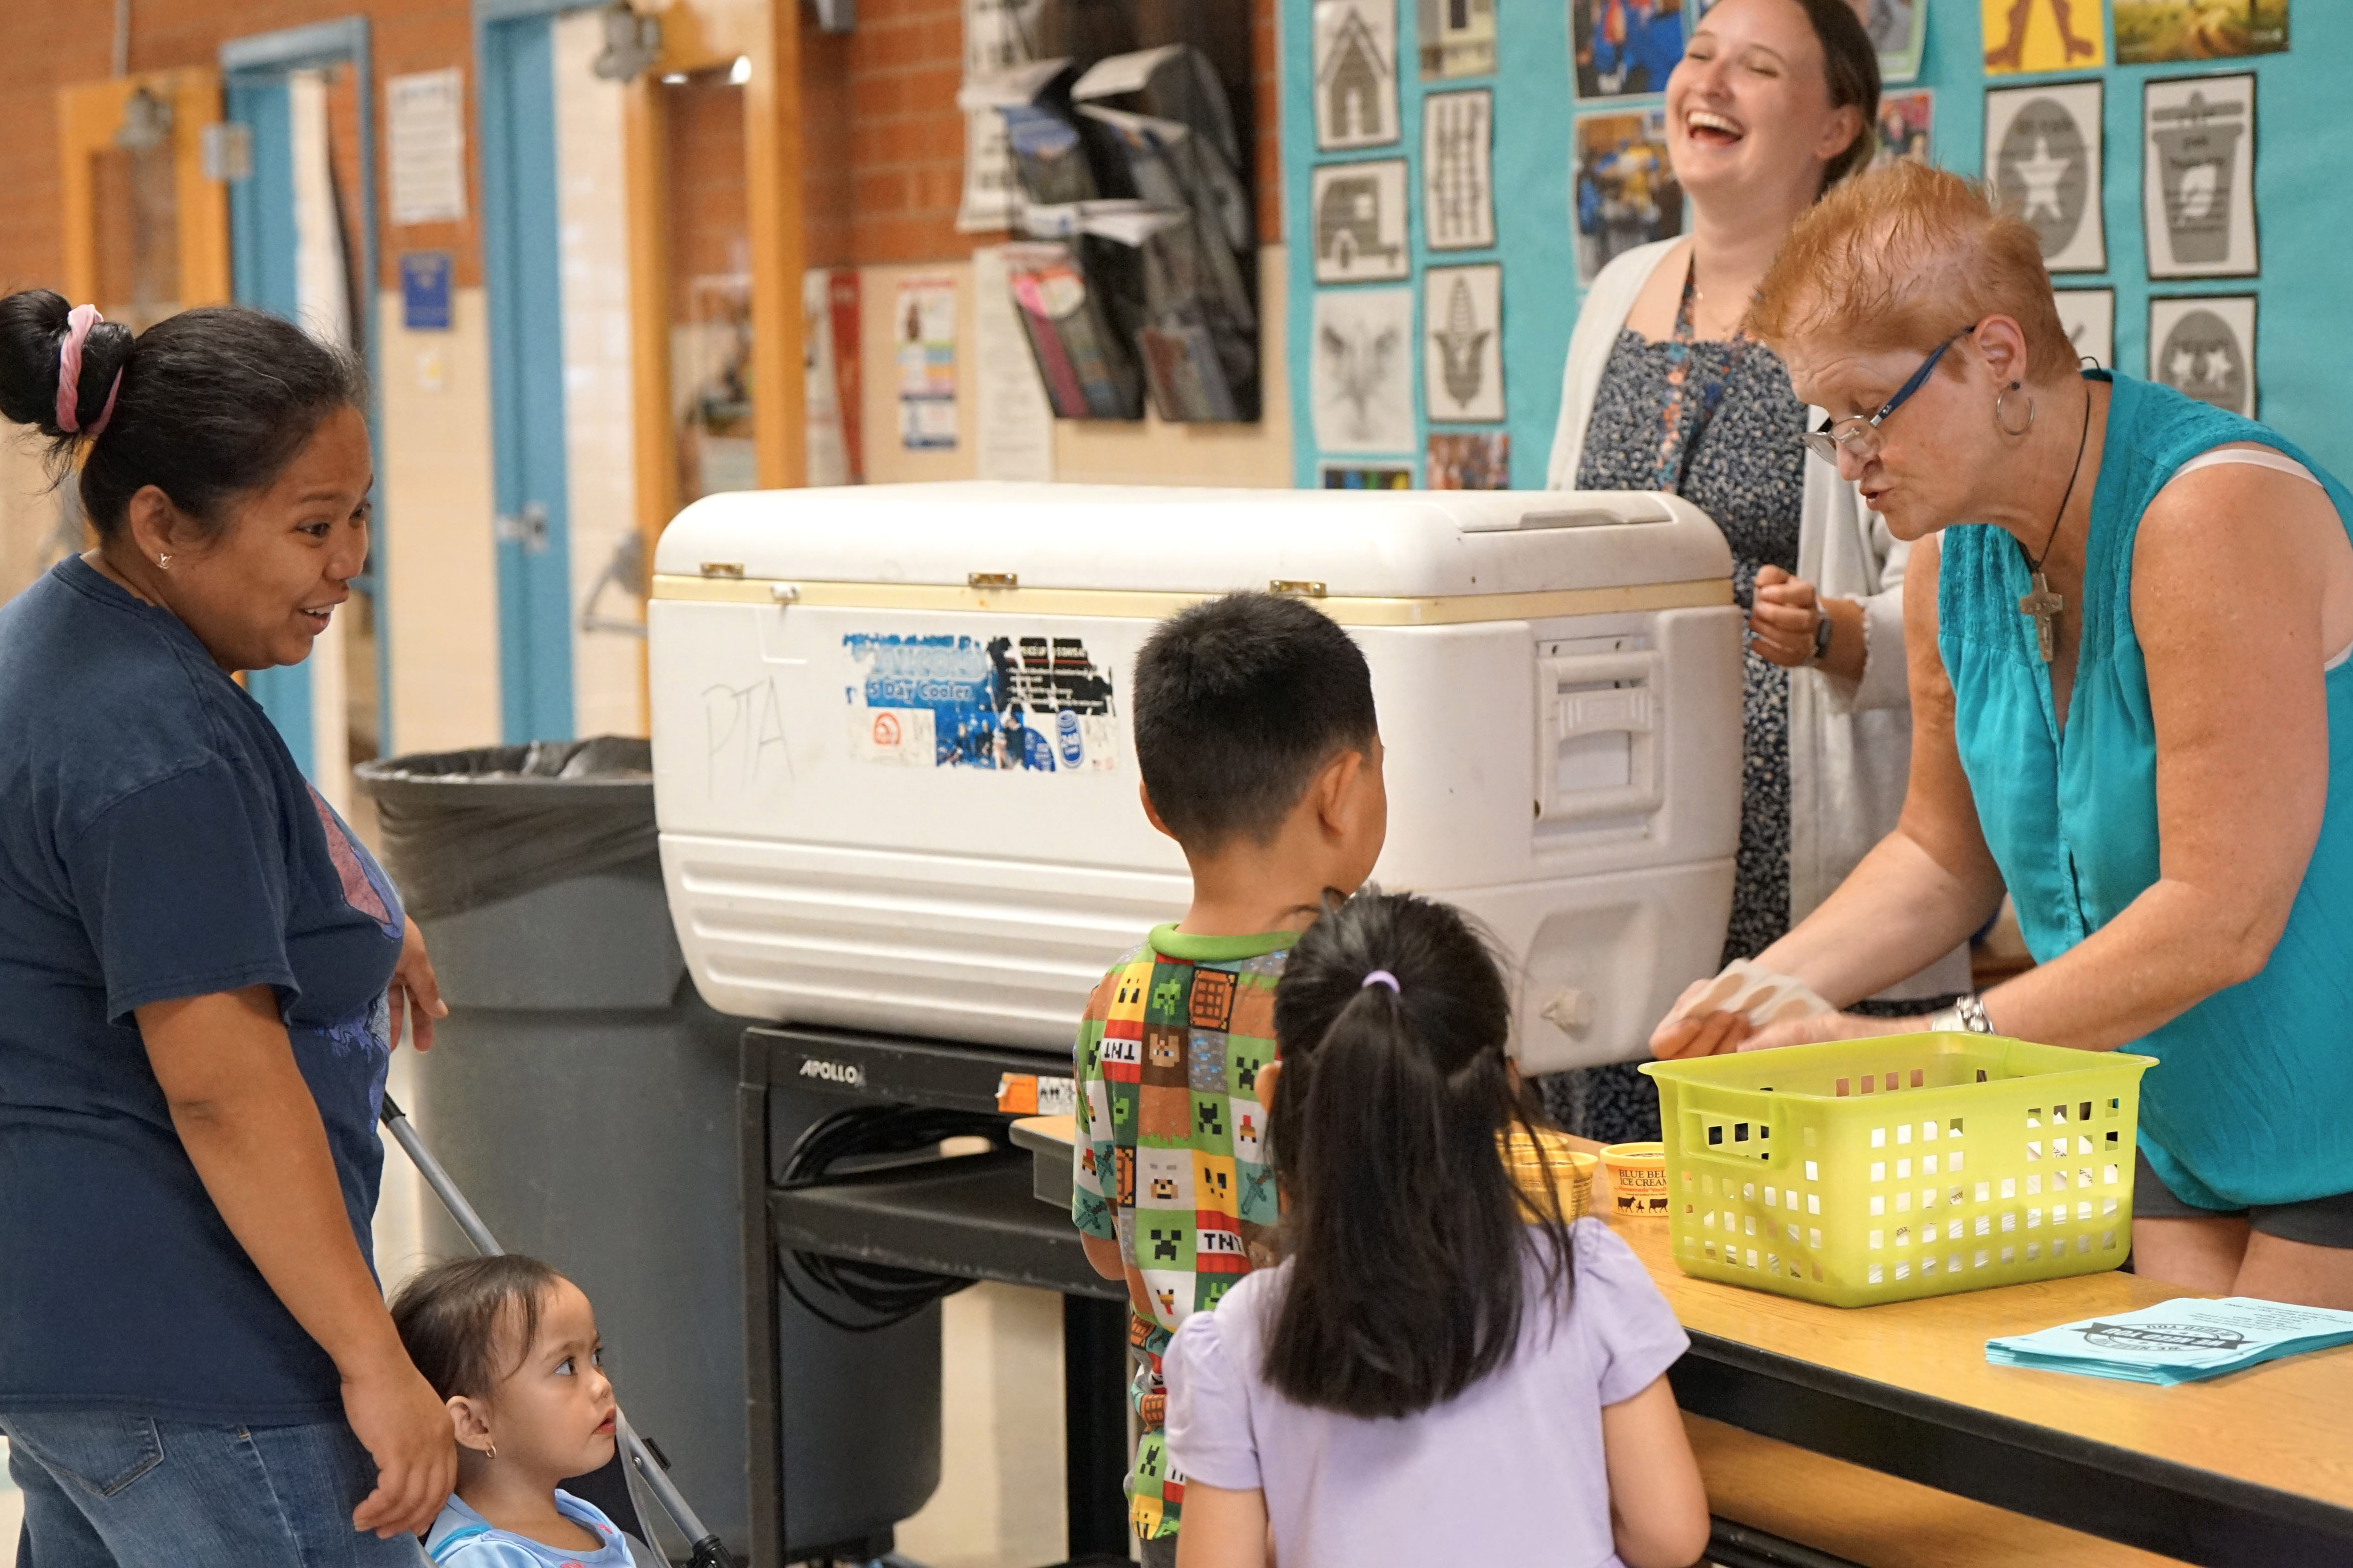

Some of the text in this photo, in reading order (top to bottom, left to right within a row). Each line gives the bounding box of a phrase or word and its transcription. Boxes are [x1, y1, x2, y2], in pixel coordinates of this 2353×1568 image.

[885, 682, 912, 701] Day
[921, 681, 970, 697] Cooler
[700, 675, 797, 800] PTA
[1104, 1042, 1134, 1060] TNT
[799, 1059, 859, 1084] APOLLO
[1619, 1169, 1645, 1178] BLUE
[1620, 1177, 1634, 1186] ICE
[2100, 1328, 2143, 1337] YOU
[2142, 1334, 2196, 1344] NEED
